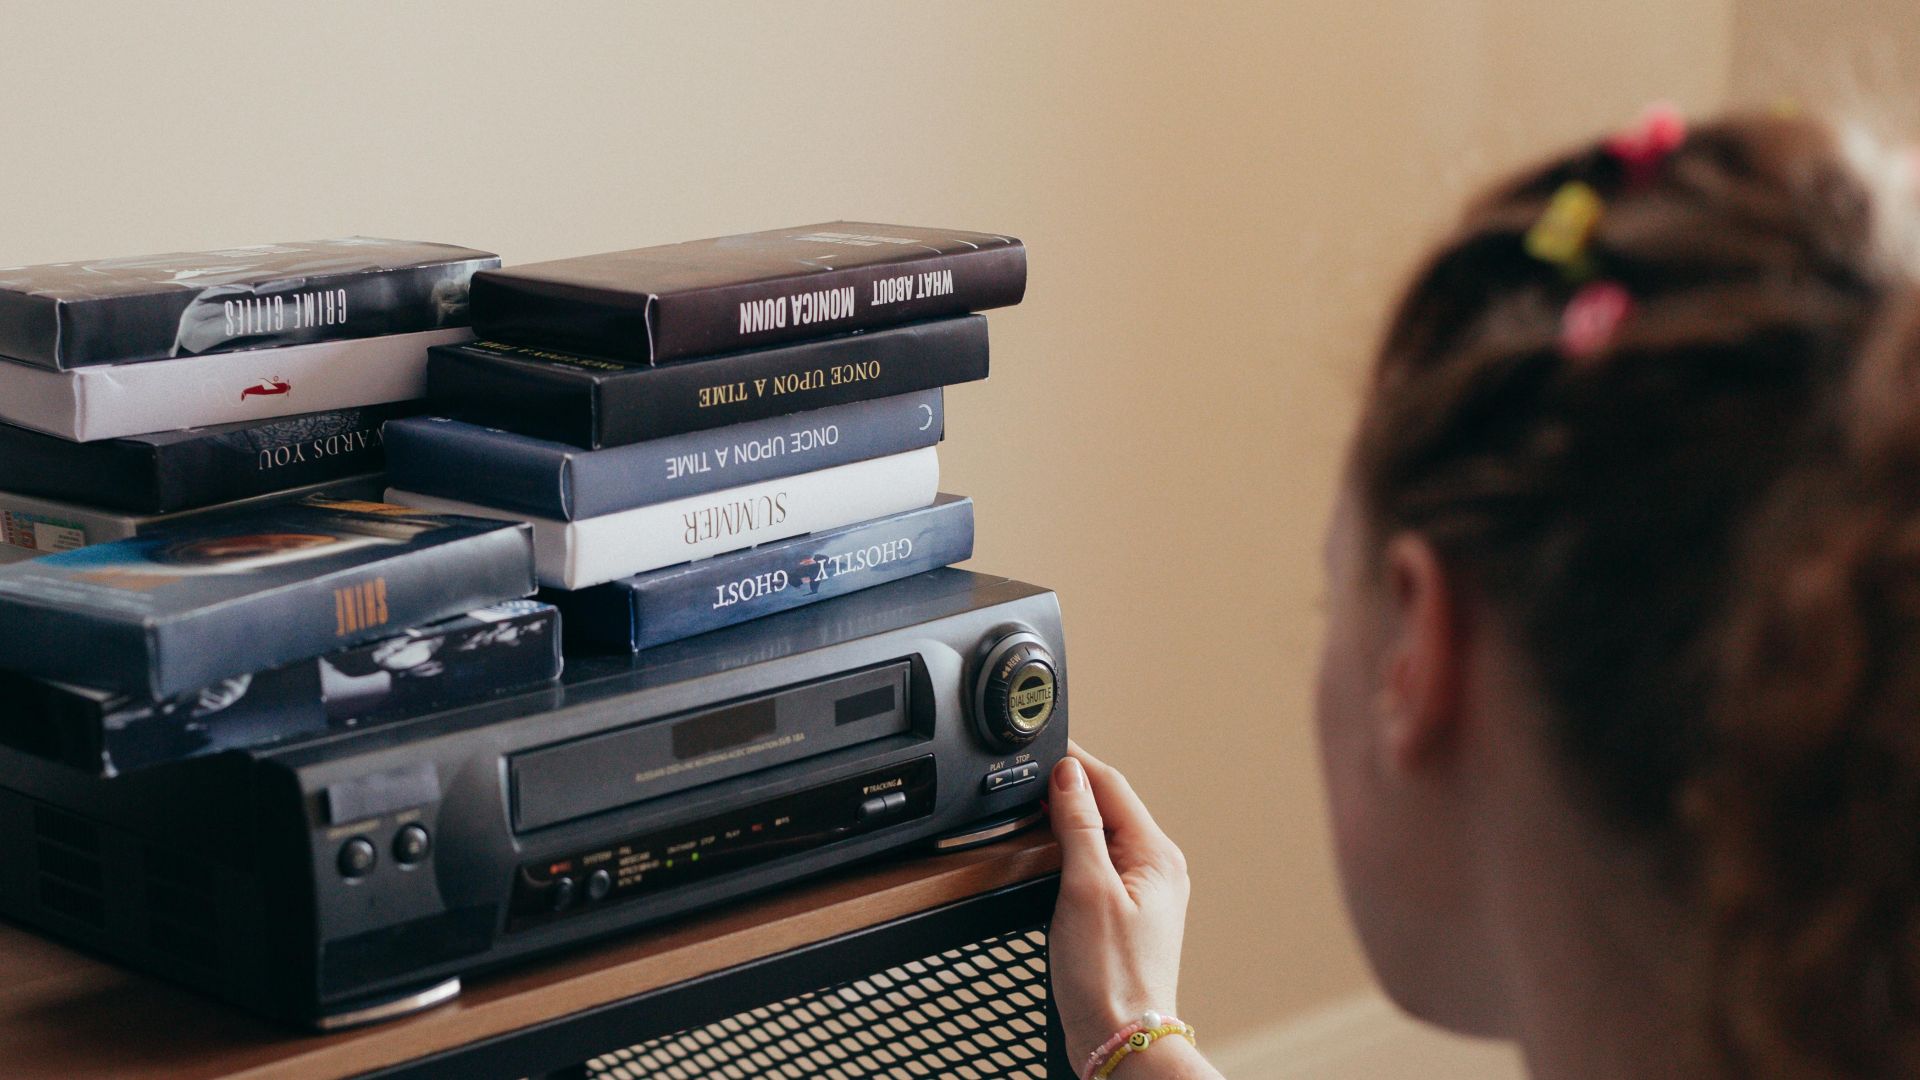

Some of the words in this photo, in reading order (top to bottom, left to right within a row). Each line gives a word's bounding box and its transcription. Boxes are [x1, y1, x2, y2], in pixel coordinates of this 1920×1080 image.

[871, 274, 913, 306] ABOUT
[916, 269, 954, 299] WHAT
[224, 295, 284, 337] CITIES
[293, 288, 347, 329] CRIME
[739, 296, 786, 334] DUNN
[791, 286, 855, 326] MONICA
[773, 369, 824, 396] UPON
[831, 360, 881, 386] ONCE
[699, 382, 748, 408] TIME
[754, 378, 768, 397] A
[735, 436, 785, 465] UPON
[791, 425, 839, 453] ONCE
[259, 443, 306, 470] YOU
[666, 455, 711, 480] TIME
[715, 447, 728, 469] A
[683, 492, 787, 545] SUMMER
[814, 537, 912, 582] GHOSTLY
[713, 570, 788, 610] GHOST
[1008, 652, 1021, 668] REW
[1010, 692, 1026, 709] DIAL
[1026, 687, 1052, 705] SHUTTLE
[989, 760, 1006, 771] PLAY
[1015, 753, 1031, 764] STOP
[868, 779, 897, 794] TRACKING
